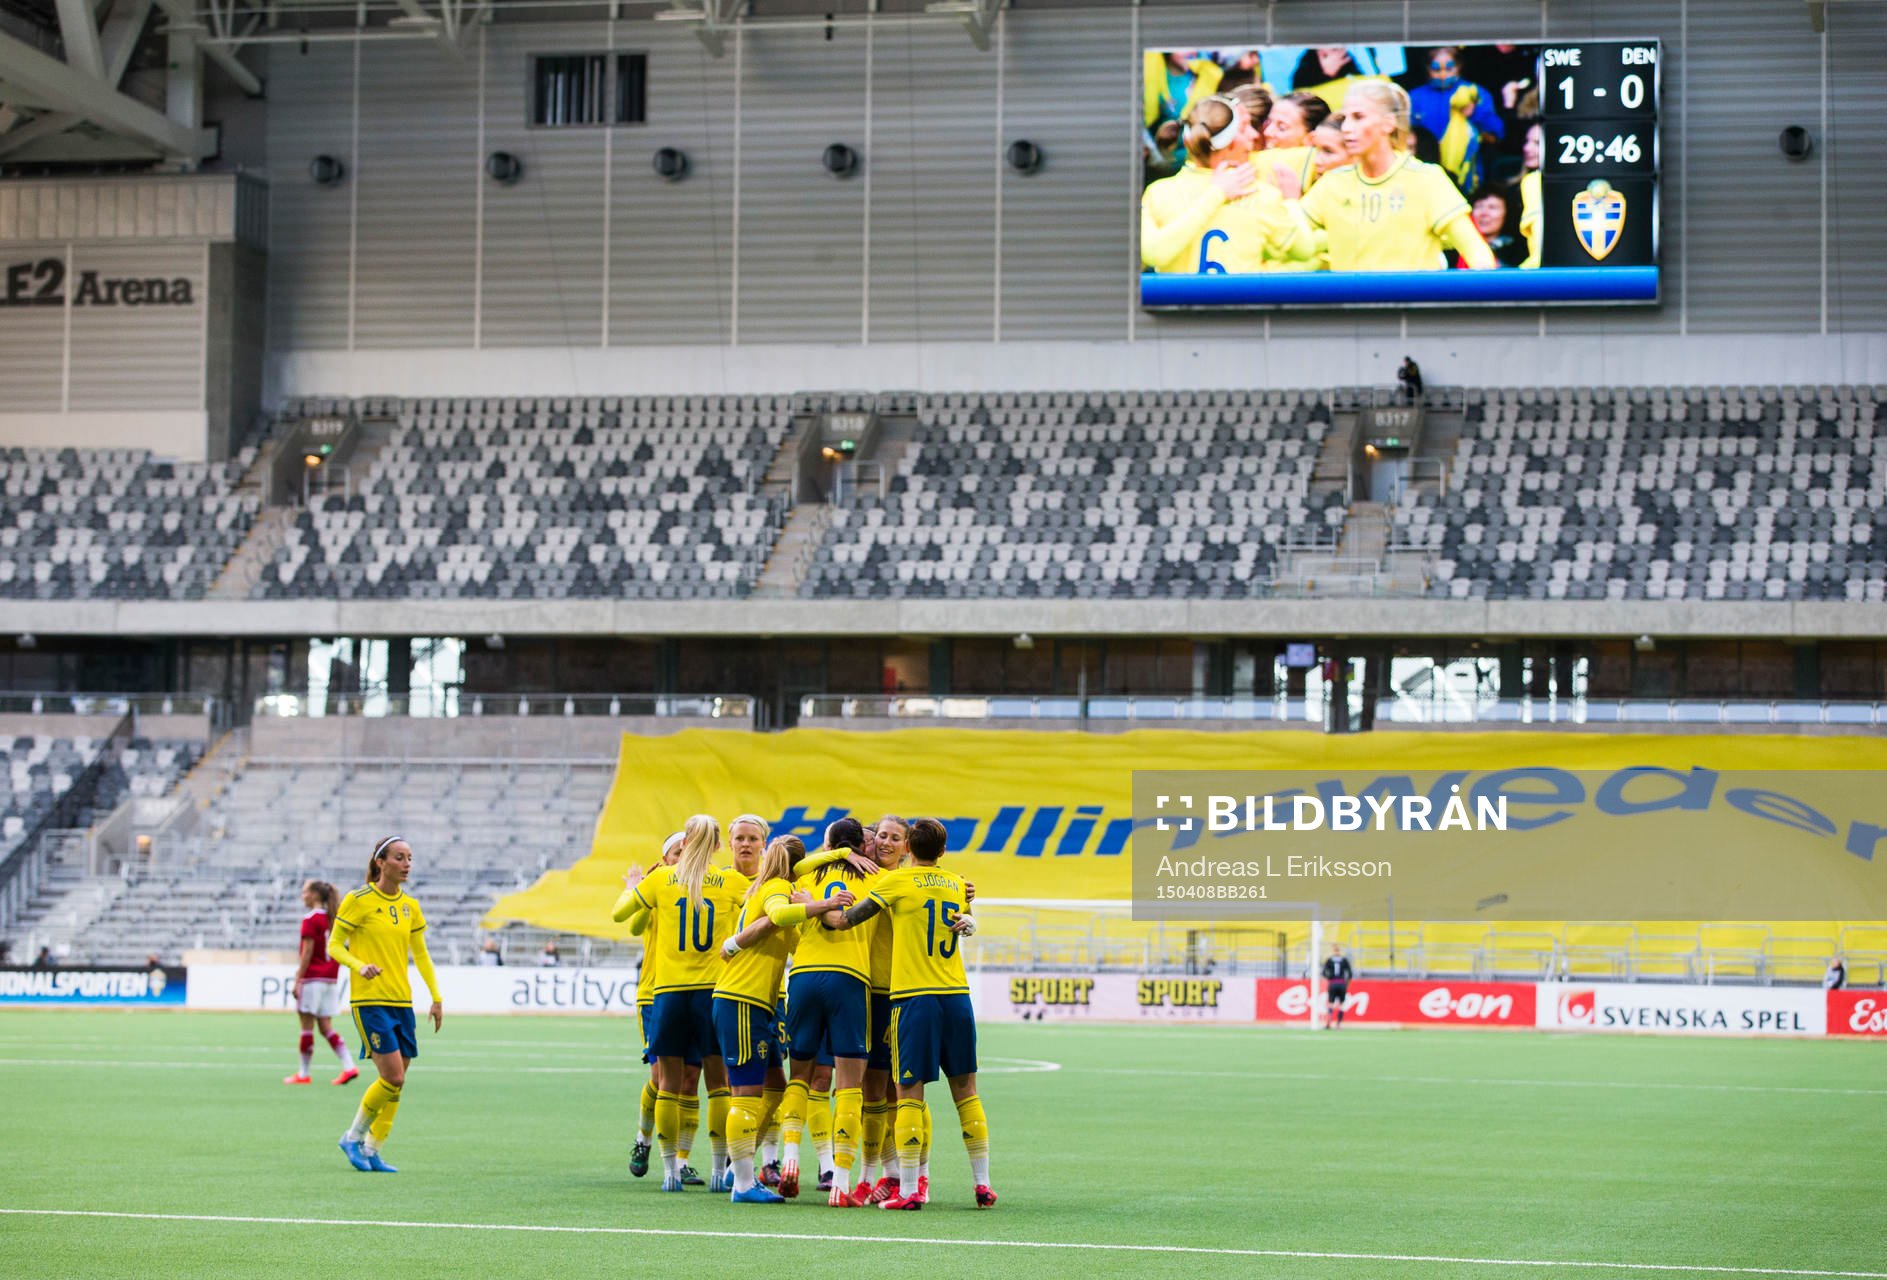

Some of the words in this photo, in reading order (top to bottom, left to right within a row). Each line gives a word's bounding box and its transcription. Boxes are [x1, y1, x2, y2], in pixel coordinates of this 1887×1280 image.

[1544, 48, 1582, 67] SWE
[1621, 46, 1657, 65] DEN
[1558, 76, 1574, 110] 1
[1620, 74, 1644, 109] 0
[1558, 134, 1641, 163] 29:46
[1361, 192, 1382, 223] 10
[72, 270, 194, 306] Arena
[666, 871, 725, 888] JASON
[389, 905, 399, 925] 9
[675, 897, 715, 952] 10
[923, 899, 960, 959] 15
[1010, 977, 1094, 1006] SPORT
[1137, 979, 1223, 1007] SPORT
[1603, 1006, 1728, 1029] SVENSKA
[1741, 1010, 1807, 1031] SPEL
